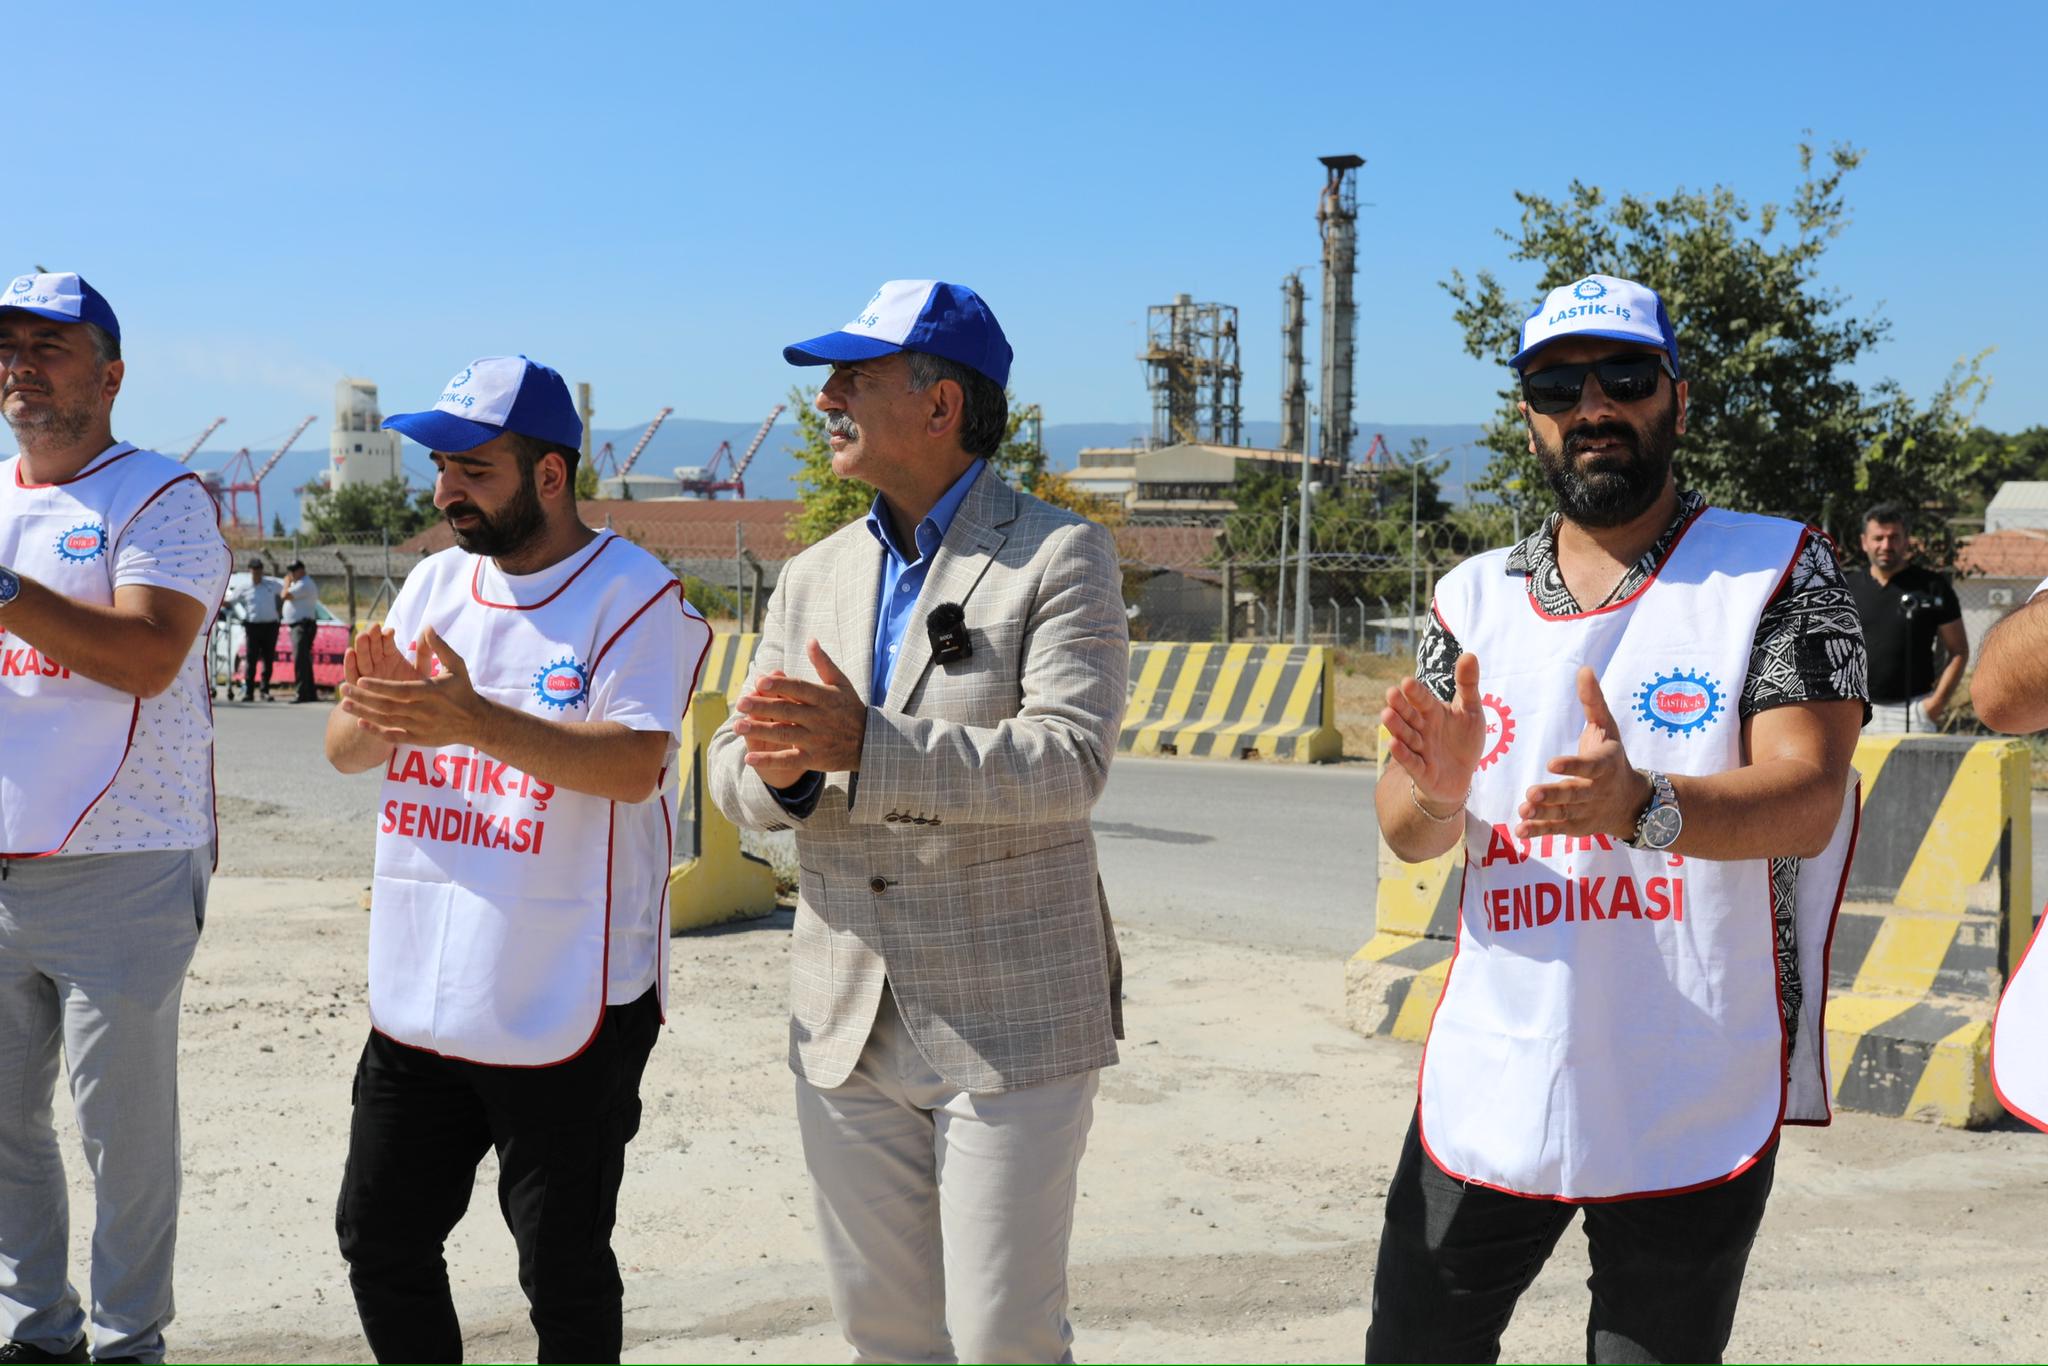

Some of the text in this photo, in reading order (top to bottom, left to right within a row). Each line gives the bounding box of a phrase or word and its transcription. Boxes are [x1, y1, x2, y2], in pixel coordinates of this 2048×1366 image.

[1548, 302, 1632, 326] LASTİK-İŞ
[381, 799, 545, 855] SENDİKASI
[1484, 865, 1684, 932] SENDİKASI
